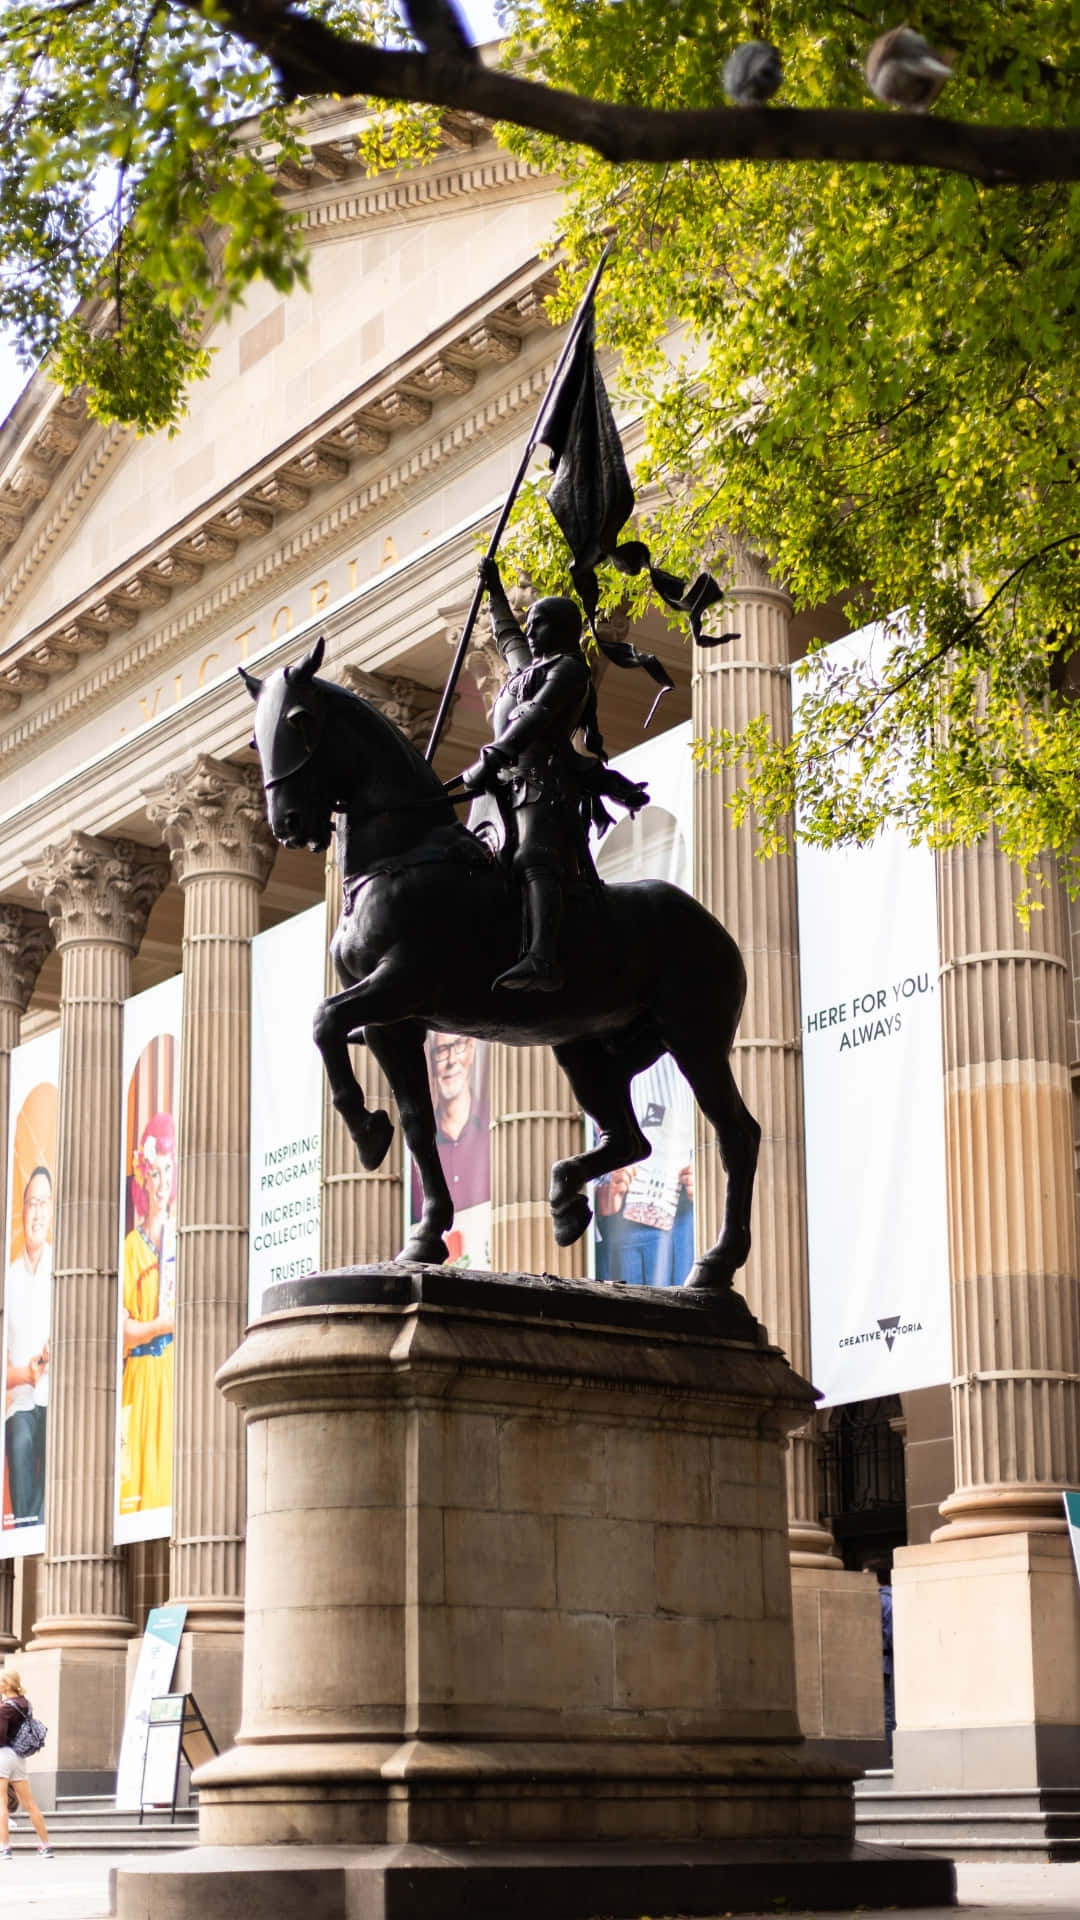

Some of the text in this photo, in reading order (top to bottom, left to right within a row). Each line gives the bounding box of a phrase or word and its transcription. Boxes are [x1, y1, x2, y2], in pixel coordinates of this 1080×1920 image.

[139, 535, 399, 722] VICTORIA
[807, 972, 934, 1033] HERE FOR YOU,
[839, 1012, 902, 1052] ALWAYS
[264, 1134, 319, 1167] INSPIRING
[270, 1257, 313, 1284] TRUSTED
[838, 1322, 923, 1348] CREATIVE VICTORIA
